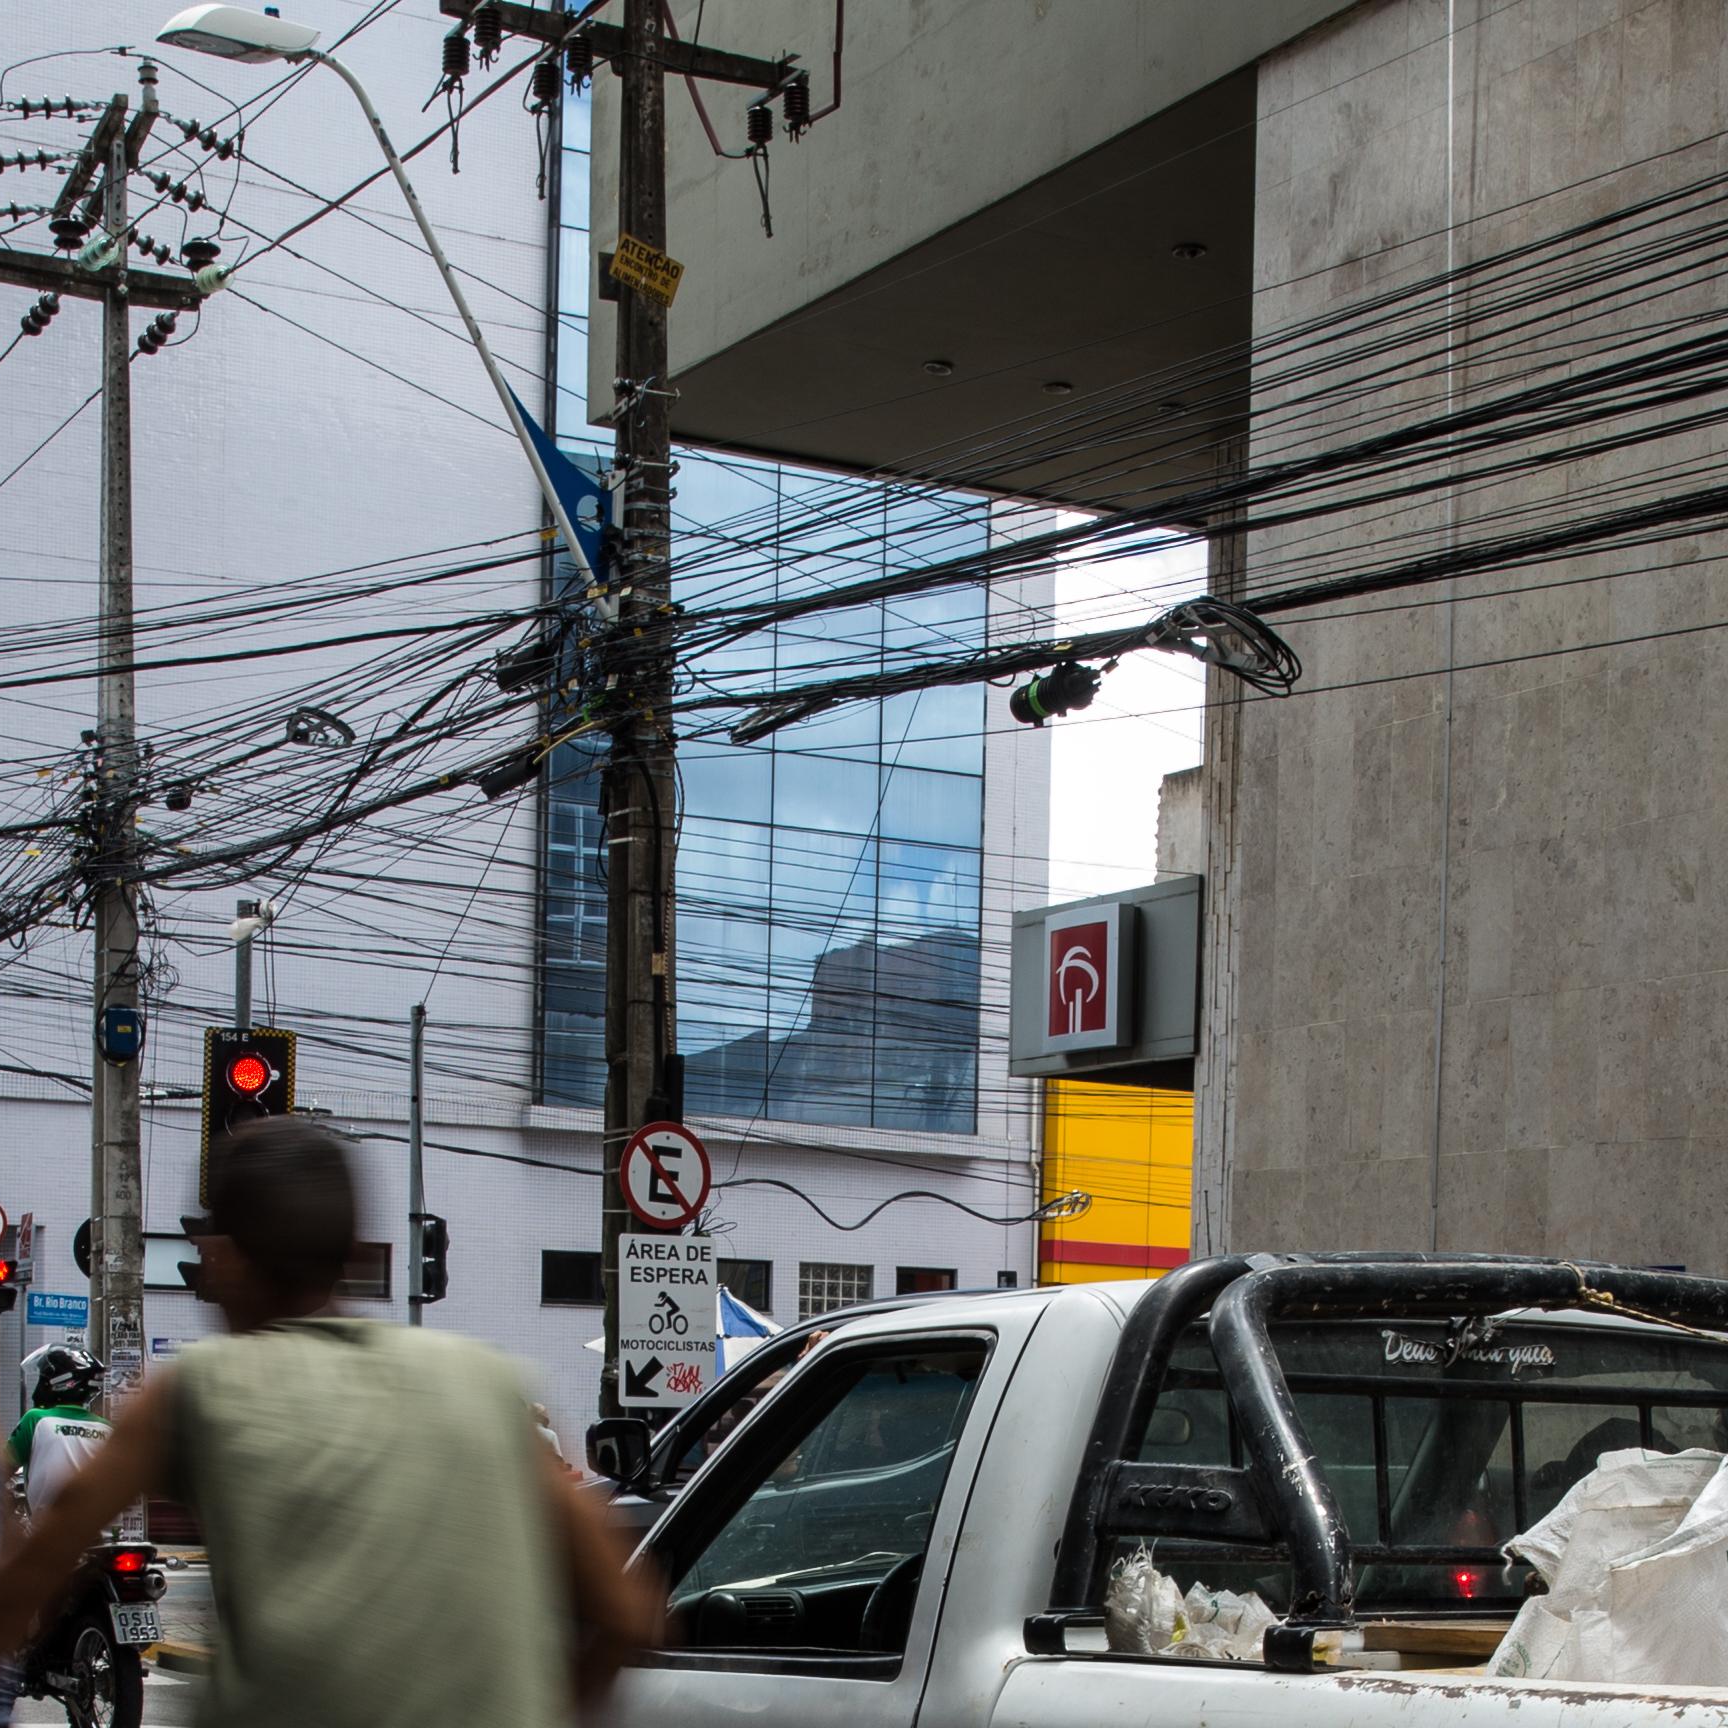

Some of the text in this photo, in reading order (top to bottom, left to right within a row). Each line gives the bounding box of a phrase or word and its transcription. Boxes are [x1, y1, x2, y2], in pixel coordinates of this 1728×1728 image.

[220, 1032, 249, 1043] 154 E
[649, 1145, 682, 1205] E
[625, 1239, 712, 1263] ÁREA DE
[630, 1267, 709, 1285] ESPERA
[45, 1296, 59, 1308] Rio
[59, 1297, 87, 1310] Branco
[621, 1339, 716, 1352] MOTOCICLISTAS
[1381, 1329, 1437, 1361] Deus
